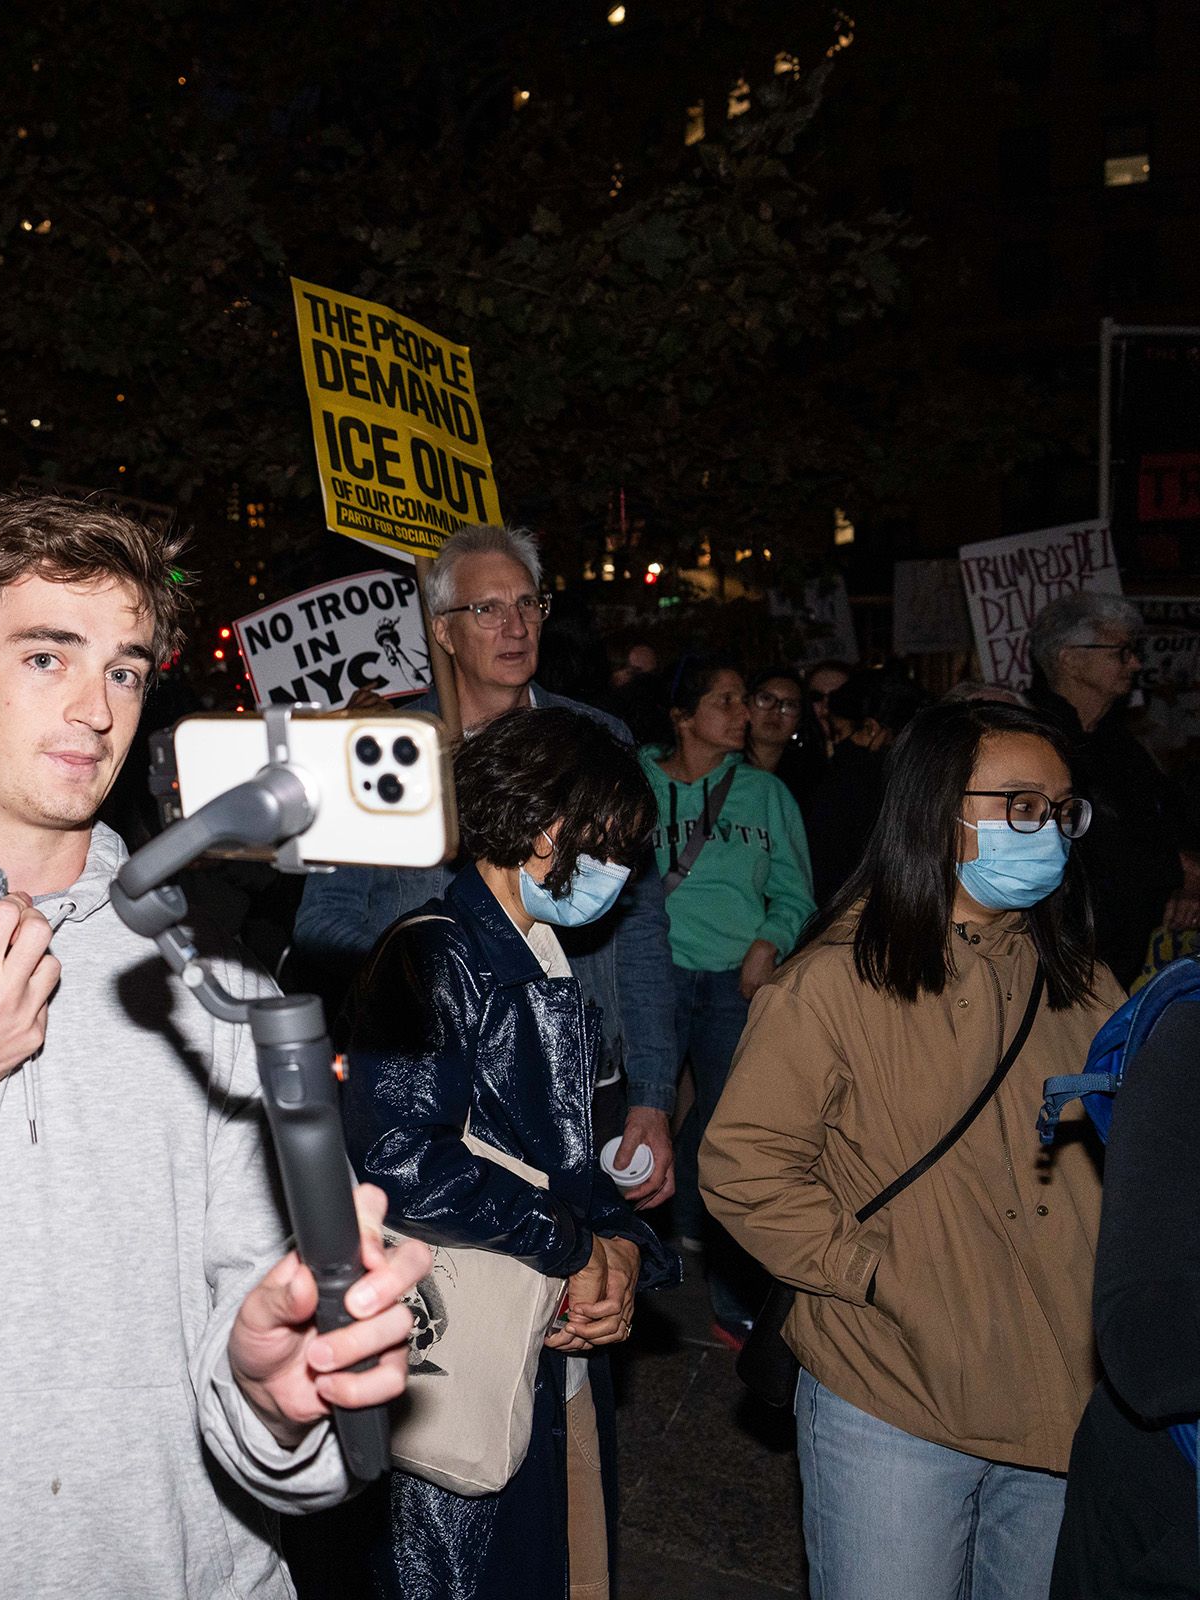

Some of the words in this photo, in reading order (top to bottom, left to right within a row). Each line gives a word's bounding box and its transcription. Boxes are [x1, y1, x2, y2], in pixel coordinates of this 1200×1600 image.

[303, 291, 367, 347] THE
[367, 311, 470, 394] PEOPLE
[311, 338, 479, 446] DEMAND
[323, 410, 406, 490] ICE
[410, 438, 488, 523] OUT
[331, 476, 353, 501] OF
[355, 484, 392, 515] OUR
[341, 508, 373, 528] PARTY
[373, 517, 394, 535] FOR
[245, 612, 294, 656] NO
[298, 577, 416, 631] TROOP
[268, 651, 390, 705] NYC
[293, 630, 342, 670] IN
